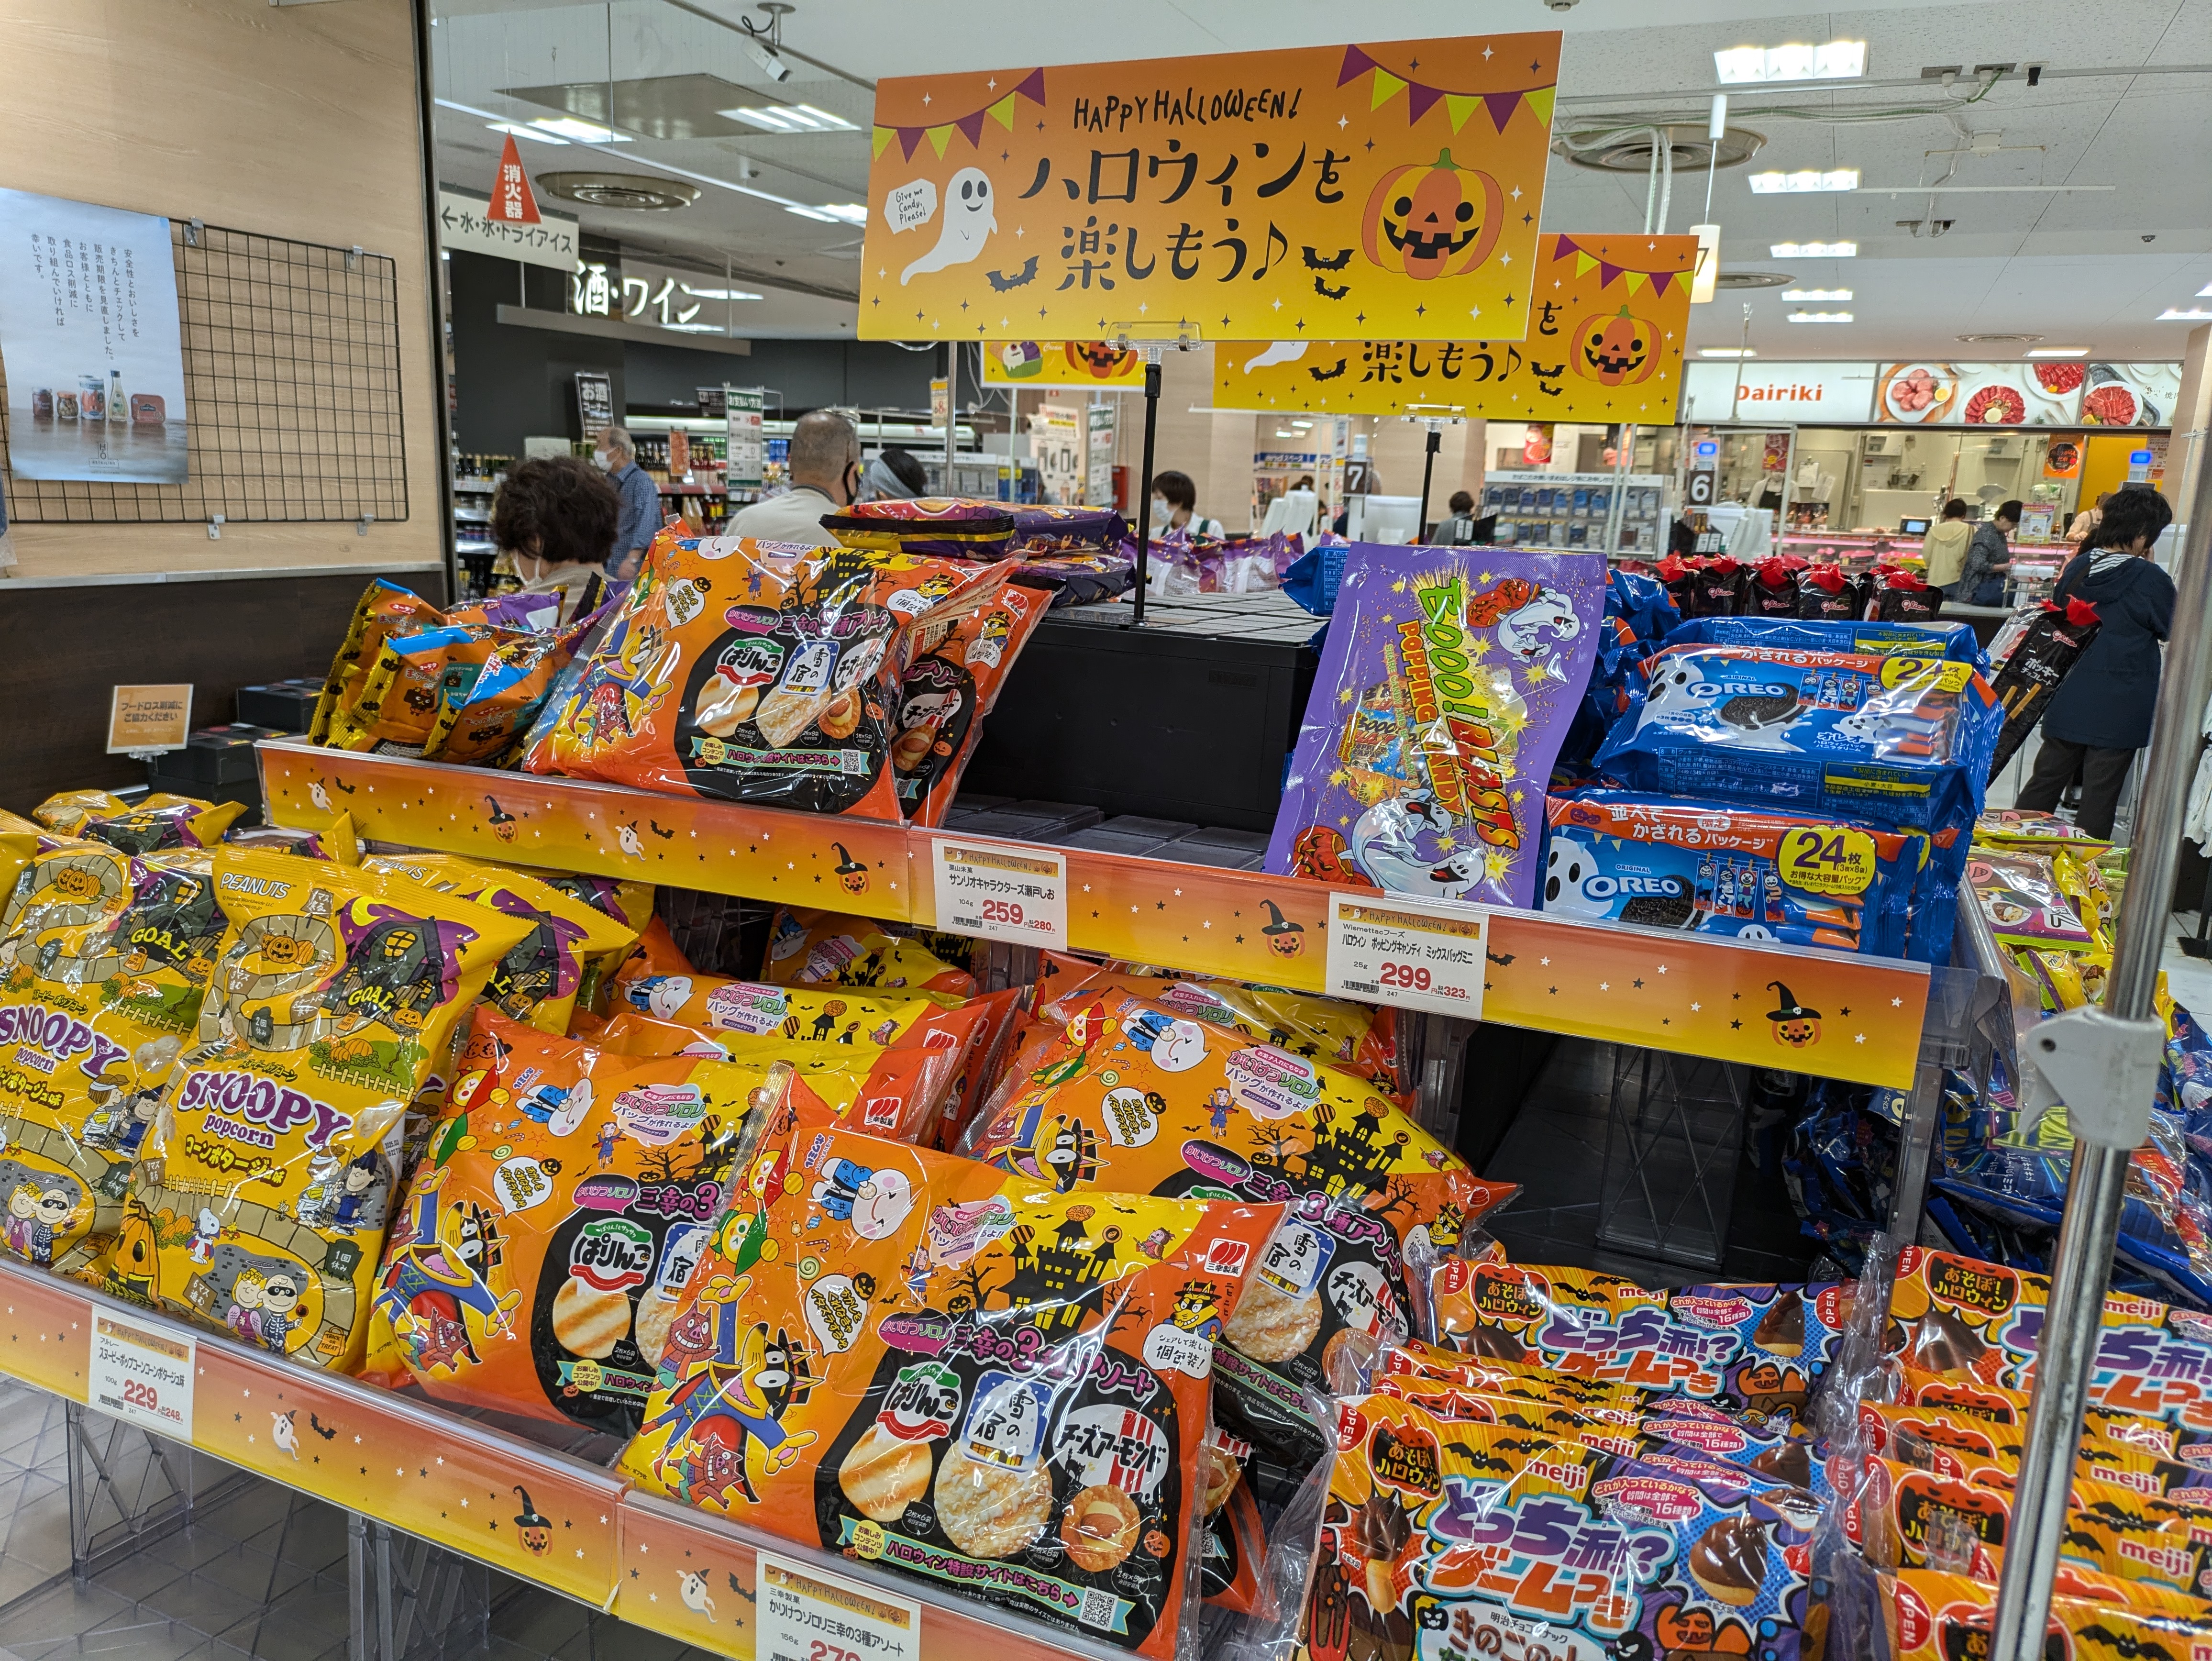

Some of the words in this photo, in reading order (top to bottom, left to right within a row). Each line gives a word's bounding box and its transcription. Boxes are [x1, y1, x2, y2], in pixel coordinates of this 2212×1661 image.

[1074, 95, 1148, 133] HAPPY
[1153, 88, 1302, 122] HALLOWEEN!
[1018, 139, 1351, 206] ハロウィンを
[504, 164, 523, 220] 消火器
[896, 192, 911, 202] Give
[899, 206, 926, 224] Please!
[31, 233, 44, 279] 幸いです。
[47, 236, 65, 326] 取り組んでいければ
[63, 239, 78, 309] 食品ロス削減に
[79, 242, 94, 312] お客様とともに
[110, 247, 125, 342] きちんとチェックして
[124, 248, 139, 337] 安全性とおいしさを
[574, 261, 700, 324] 酒・ワイン
[1538, 300, 1562, 336] を
[581, 382, 608, 402] お酒
[1737, 384, 1822, 401] Dairiki
[1348, 465, 1363, 491] 7
[1691, 475, 1710, 502] 6
[1708, 587, 1734, 598] Glico
[1762, 599, 1789, 610] Glico
[471, 630, 493, 642] ブラック
[525, 640, 556, 672] ブラック
[720, 646, 782, 673] ぱりんこ
[1385, 643, 1397, 674] SHARE
[1418, 576, 1489, 720] BOOO!
[1395, 619, 1440, 725] POPPING
[2020, 666, 2053, 686] チョコレート
[2024, 656, 2059, 679] ポッキー
[1390, 675, 1402, 709] CANDY
[1690, 683, 1786, 696] OREO
[122, 701, 183, 711] フードロス削減に
[124, 712, 178, 722] ご協力ください
[1396, 709, 1406, 727] AND
[1816, 731, 1864, 744] オレオ
[1402, 745, 1417, 776] SCARY
[1446, 715, 1520, 851] BLASTS
[1610, 805, 1664, 822] 並べて
[949, 864, 973, 874] 栗山米菓
[969, 853, 990, 865] HAPPY
[992, 855, 1031, 871] HALLOWEEN!
[1615, 864, 1651, 874] ORIGINAL
[221, 873, 291, 899] PEANUTS
[949, 874, 1055, 900] サンリオキャラクターズ瀬戸しお
[1586, 876, 1681, 897] OREO
[959, 899, 973, 907] 104g
[983, 899, 1024, 925] 259
[1034, 920, 1051, 931] 280
[1343, 923, 1405, 938] Wismettacフーズ
[1370, 911, 1395, 924] HAPPY
[1397, 914, 1447, 932] HALLOWEEN!
[131, 927, 190, 962] GOAL
[1342, 934, 1366, 948] ハロウィン
[1353, 962, 1368, 970] 25g
[1380, 962, 1431, 991] 299
[349, 986, 395, 1013] GOAL
[1444, 986, 1466, 998] 323
[54, 995, 88, 1015] ポップコーン
[708, 1000, 779, 1029] バッグが作れるよ!!
[255, 1017, 266, 1027] 2回
[0, 1005, 130, 1076] SNOOPY
[14, 1047, 55, 1073] popcorn
[1257, 1050, 1307, 1077] お菓子入れにもなる!
[1225, 1067, 1309, 1112] バッグが作れるよ!!
[1243, 1090, 1278, 1108] オリジナルデザイン
[181, 1070, 352, 1149] SNOOPY
[613, 1107, 696, 1129] バッグが作れるよ!!
[1107, 1095, 1135, 1145] イタズラするぞ
[1122, 1098, 1140, 1136] くれなきゃ
[1132, 1098, 1152, 1130] おかしを
[203, 1112, 276, 1148] popcorn
[631, 1124, 667, 1136] オリジナルデザイン
[867, 1116, 894, 1128] 三幸製菓
[1184, 1145, 1249, 1177] かいけつゾロリ
[577, 1185, 635, 1198] かいけつゾロリ
[335, 1254, 351, 1263] 1回
[575, 1233, 652, 1271] ぱりんこ
[331, 1262, 348, 1273] 休み
[1206, 1262, 1239, 1274] 三幸製菓
[194, 1280, 211, 1295] 6マス
[1944, 1267, 2001, 1295] あそぼ!
[189, 1292, 206, 1307] 進む
[841, 1286, 863, 1322] おかしを
[1671, 1298, 1746, 1308] どれが入っているかな?
[1825, 1291, 1836, 1323] OPEN
[1934, 1283, 2009, 1312] ハロウィン
[811, 1288, 848, 1350] イタズラするぞ
[827, 1291, 853, 1333] くれなきゃ
[1718, 1311, 1750, 1323] 16種類!
[881, 1319, 949, 1339] かいけつゾロリ
[1158, 1332, 1212, 1354] シェアして楽しい
[576, 1364, 598, 1373] お楽しみ
[1155, 1344, 1206, 1373] 個包装!
[574, 1372, 601, 1381] コンテンツ
[577, 1378, 598, 1387] 公開中!
[124, 1379, 158, 1410] 229
[886, 1379, 961, 1420] ぱりんこ
[166, 1407, 180, 1421] 248
[1340, 1405, 1358, 1447] OPEN
[1054, 1422, 1169, 1474] チーズアーモンド
[1526, 1457, 1587, 1489] meiji
[2093, 1466, 2161, 1494] meiji
[1594, 1478, 1698, 1496] どれが入っているかな?
[1626, 1491, 1678, 1502] 質問は全部で
[906, 1509, 932, 1523] 2枚×6袋
[1656, 1502, 1697, 1515] 16種類!
[854, 1533, 883, 1549] コンテンツ
[858, 1525, 882, 1539] お楽しみ
[856, 1542, 878, 1555] 公開中!
[2120, 1539, 2193, 1578] meiji
[886, 1540, 1062, 1601] ハロウィン特設サイトはこちら
[769, 1587, 800, 1604] 三幸製菓
[780, 1632, 799, 1645] 156g
